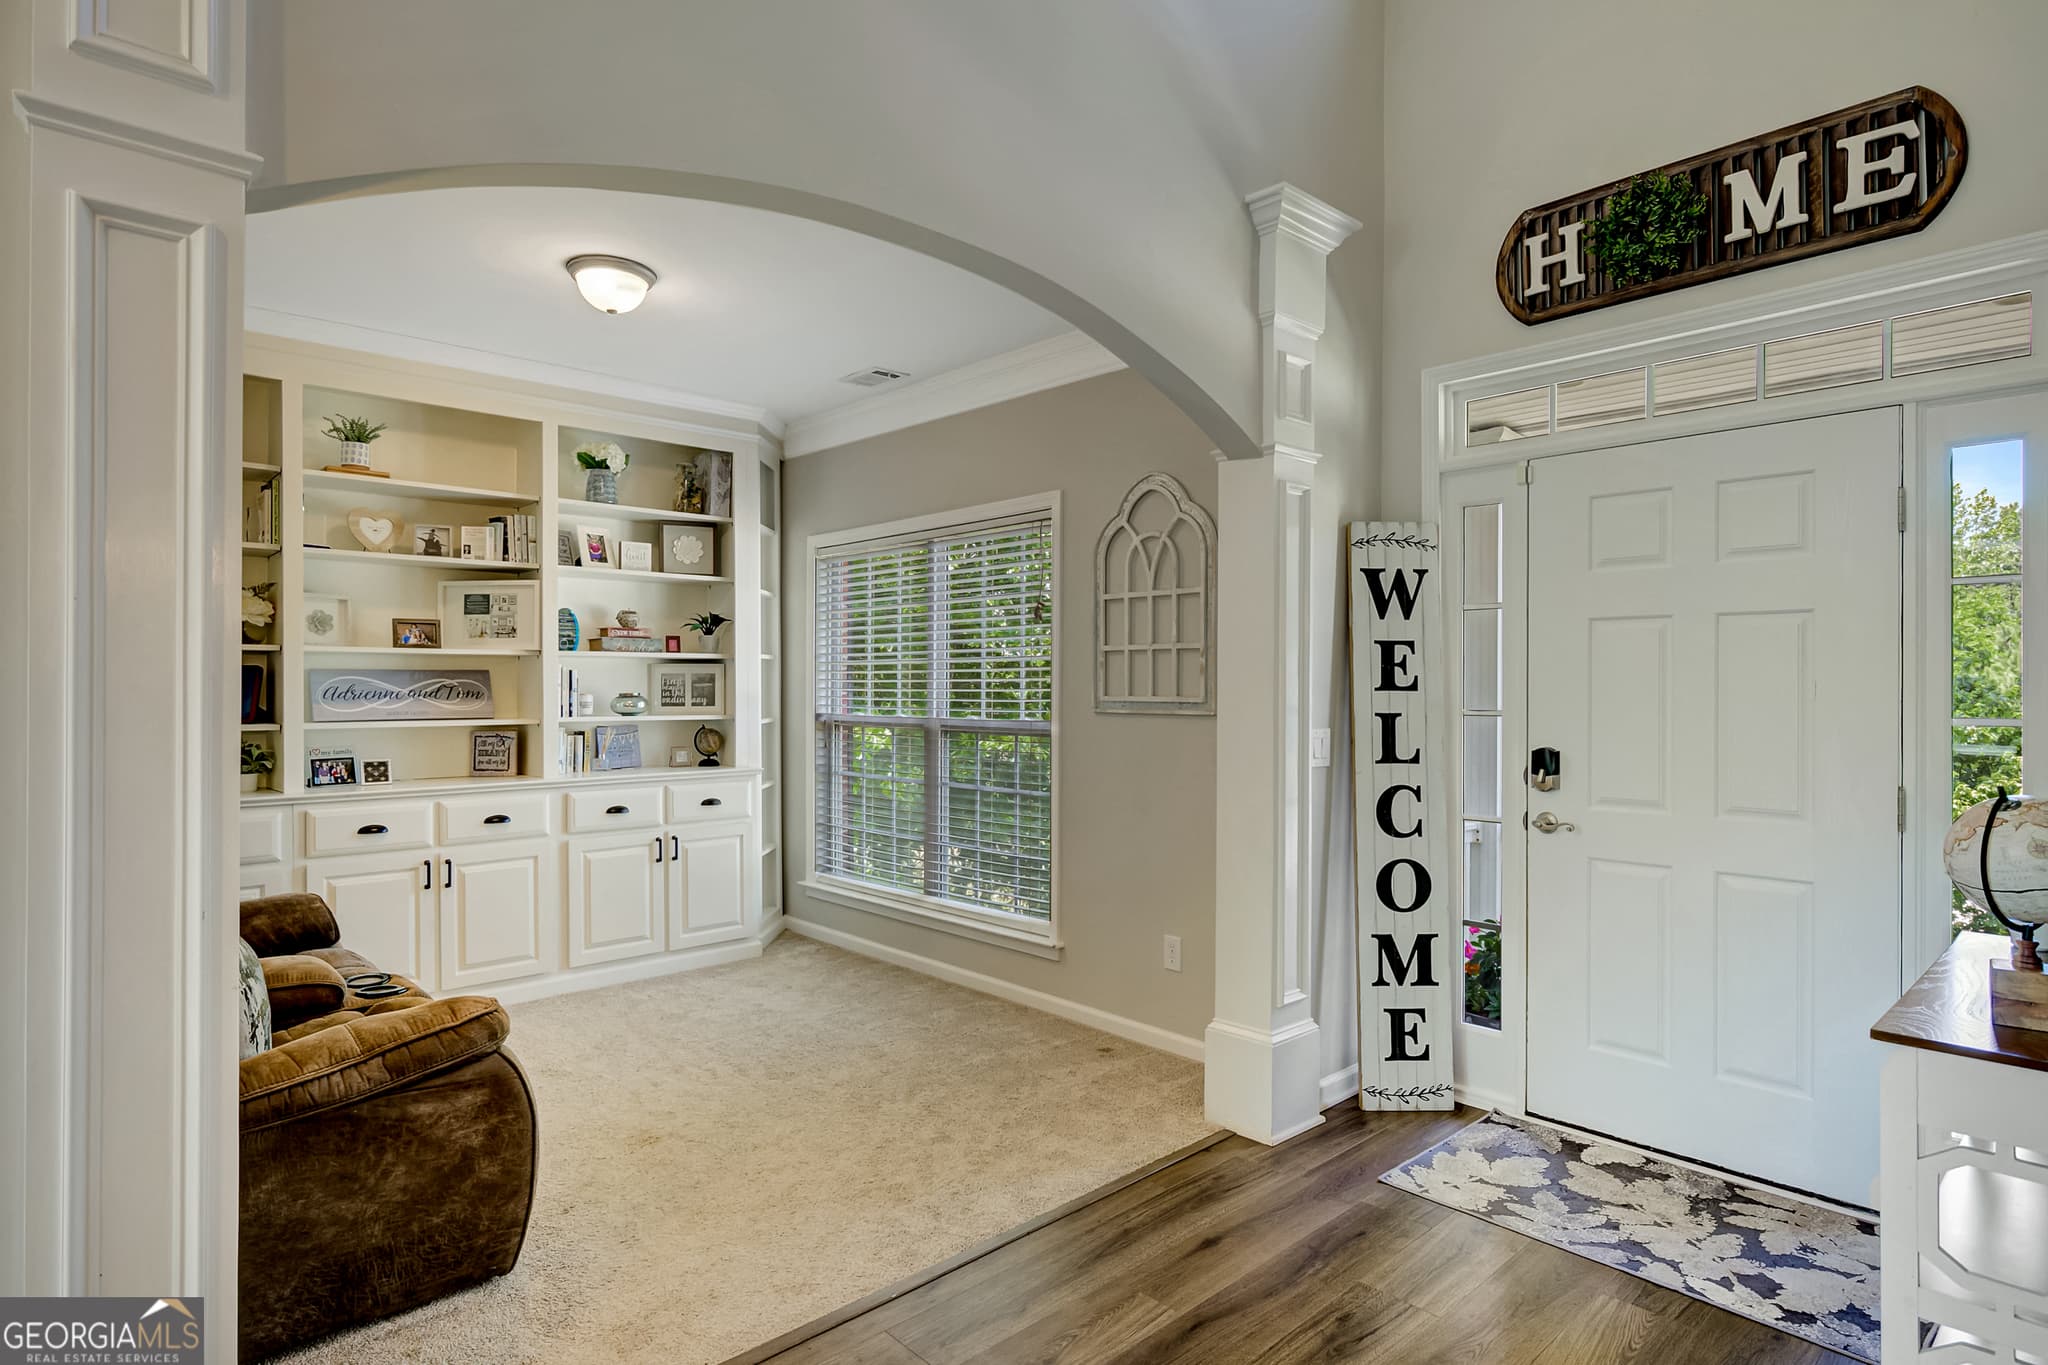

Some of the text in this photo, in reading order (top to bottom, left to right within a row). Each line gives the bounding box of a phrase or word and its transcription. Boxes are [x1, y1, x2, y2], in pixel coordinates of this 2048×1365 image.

[1523, 120, 1921, 298] HME
[322, 682, 484, 701] Adrienne and Tom
[1359, 567, 1440, 1062] WELCOME
